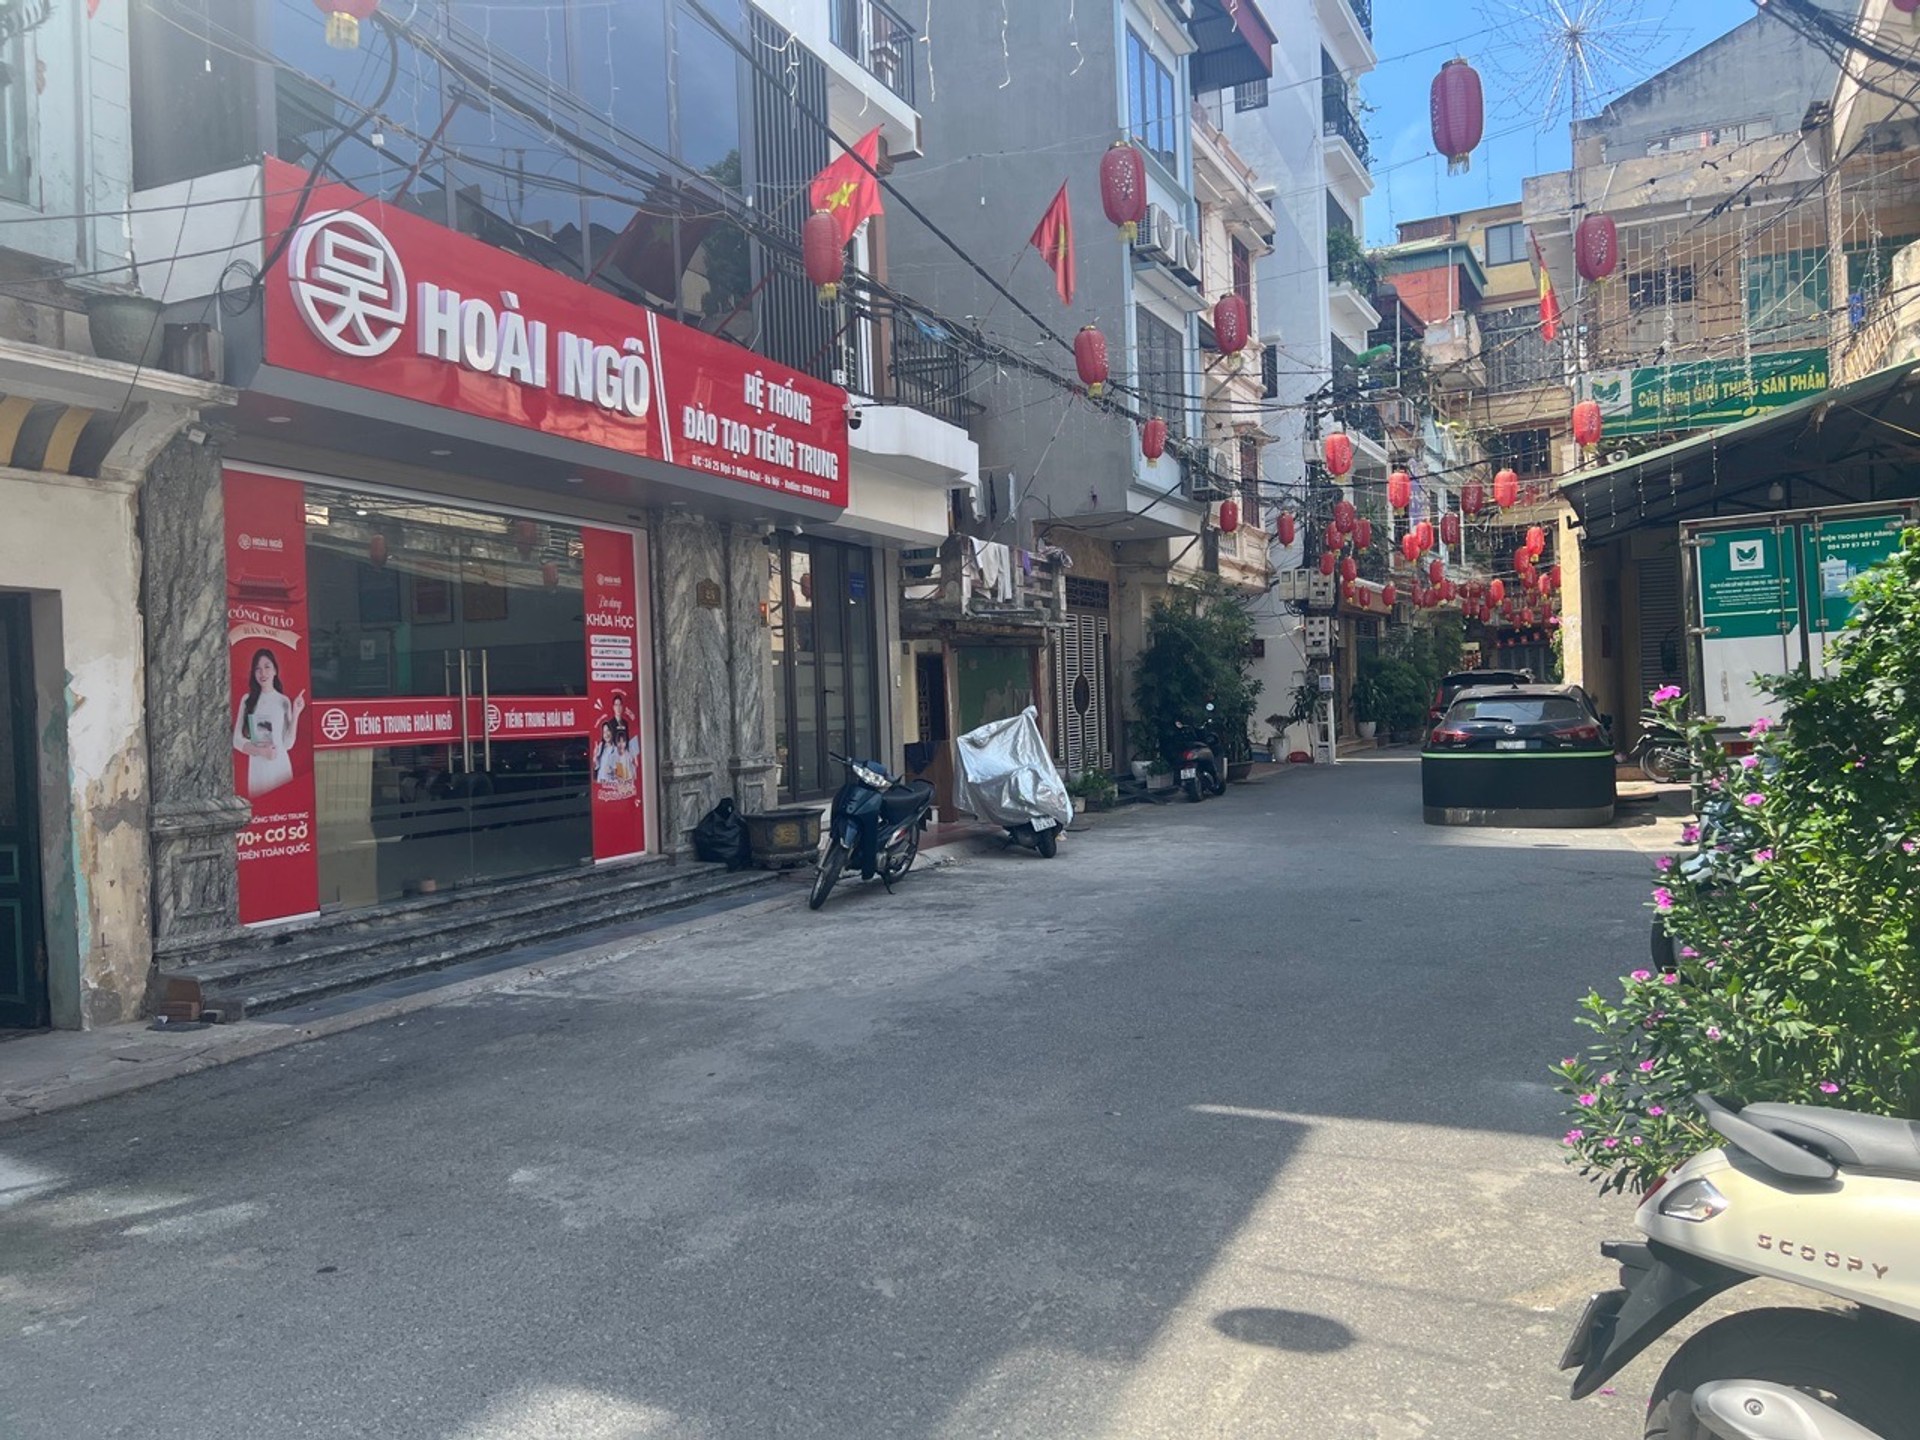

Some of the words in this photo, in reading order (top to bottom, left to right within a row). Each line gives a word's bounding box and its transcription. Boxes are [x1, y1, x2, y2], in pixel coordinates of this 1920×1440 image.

[417, 282, 547, 388] HOÀI
[558, 331, 650, 416] NGÔ
[1761, 370, 1787, 395] SẢN
[1789, 365, 1826, 392] PHẨM
[744, 371, 764, 415] HỆ
[767, 377, 812, 425] THỐNG
[683, 403, 717, 445] ĐÀO
[720, 418, 750, 459] TẠO
[752, 423, 795, 468] TIẾNG
[796, 442, 839, 481] TRUNG
[615, 615, 634, 631] HỌC
[354, 710, 381, 735] TIẾNG
[383, 714, 412, 733] TRUNG
[413, 711, 433, 732] HOÀI
[435, 710, 453, 731] NGÔ
[504, 707, 524, 729] TIẾNG
[524, 711, 546, 728] TRUNG
[235, 831, 262, 847] 70+
[264, 825, 286, 843] CƠ
[287, 820, 308, 840] SỞ
[237, 848, 260, 861] TRÊN
[261, 845, 285, 858] TOÀN
[286, 842, 310, 855] QUỐC
[1758, 1234, 1888, 1279] SCOOPY
